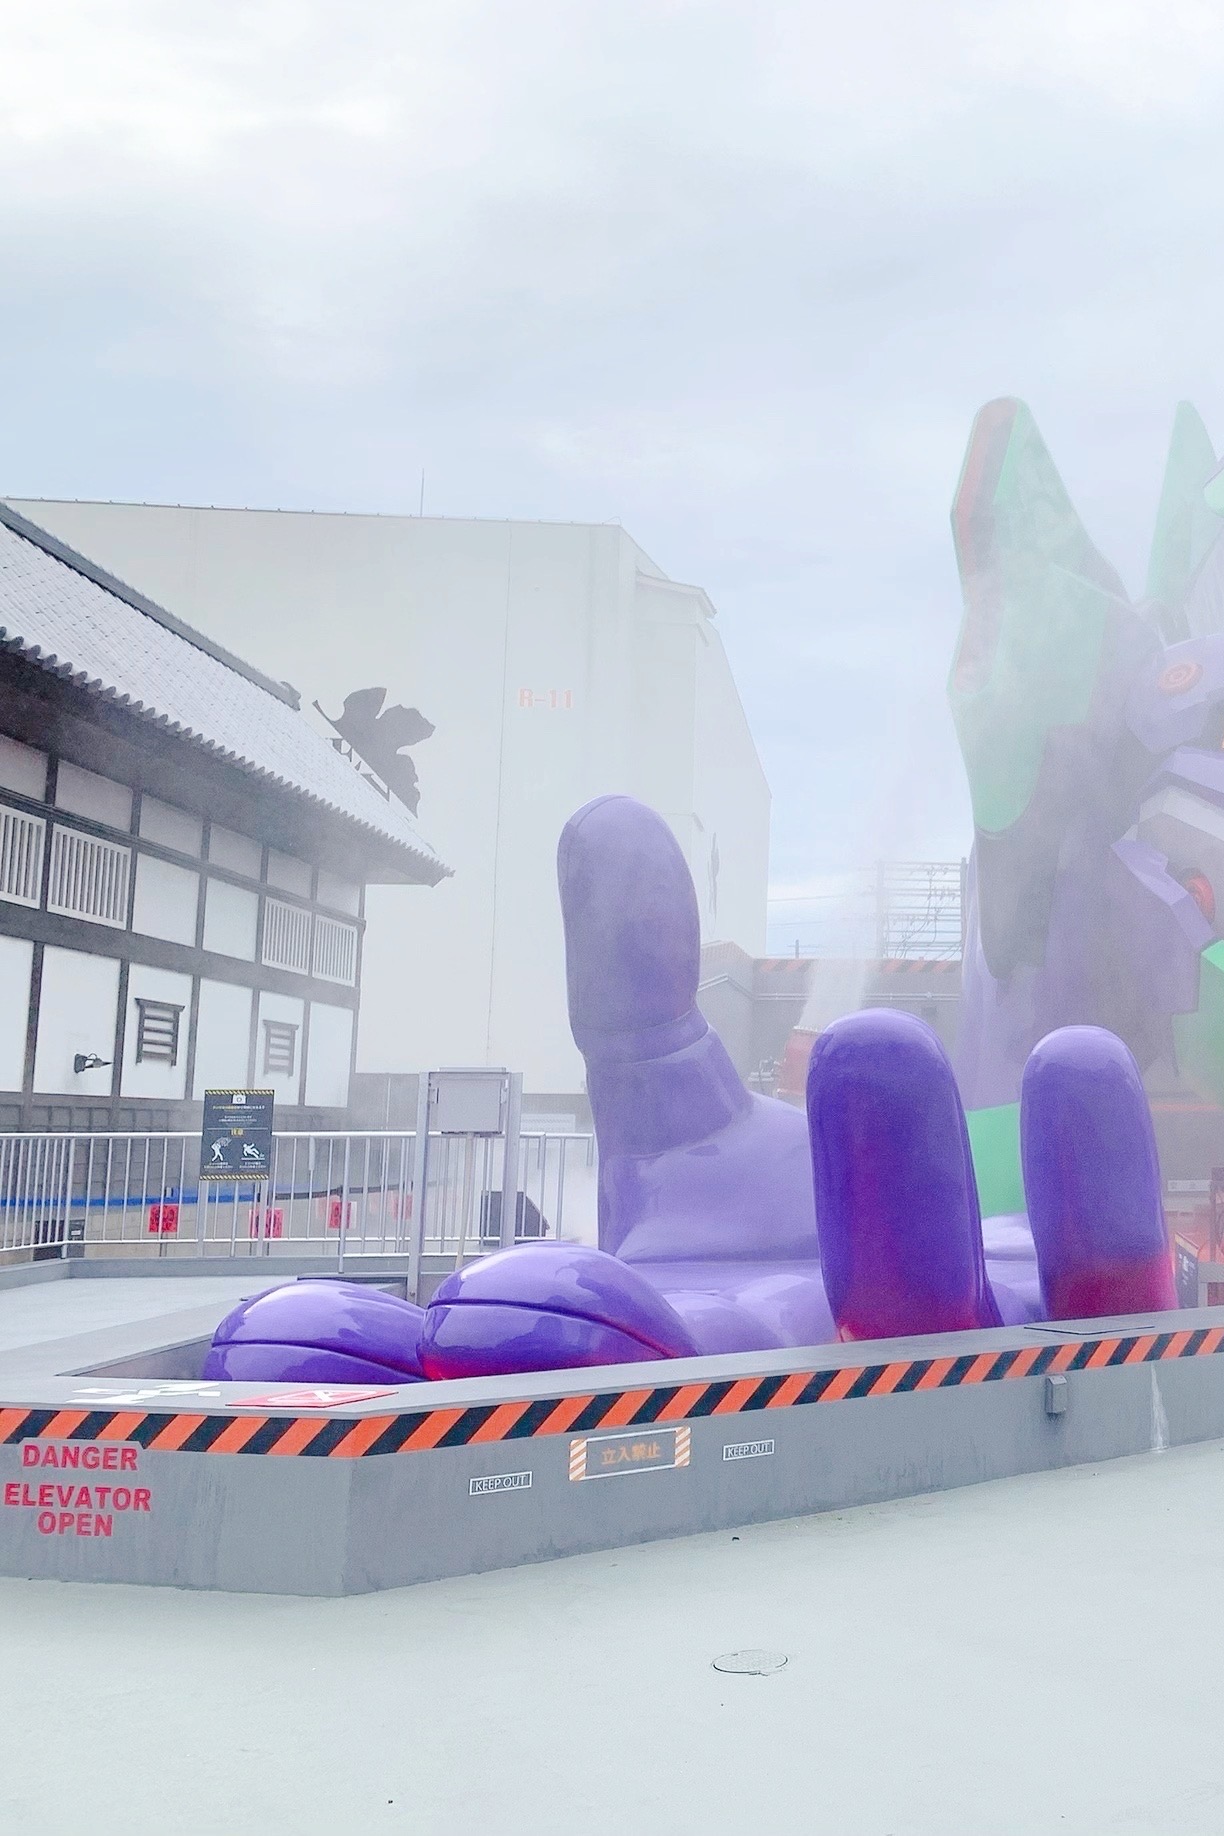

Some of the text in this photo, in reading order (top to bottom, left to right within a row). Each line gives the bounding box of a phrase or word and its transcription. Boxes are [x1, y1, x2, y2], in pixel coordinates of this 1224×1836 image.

[519, 688, 572, 709] R-11
[22, 1444, 138, 1471] DANGER
[601, 1442, 661, 1465] 立入禁止
[727, 1442, 770, 1457] KEEP OUT
[475, 1475, 527, 1491] KEEP OUT
[4, 1483, 152, 1512] ELEVATOR
[38, 1511, 113, 1537] OPEN
